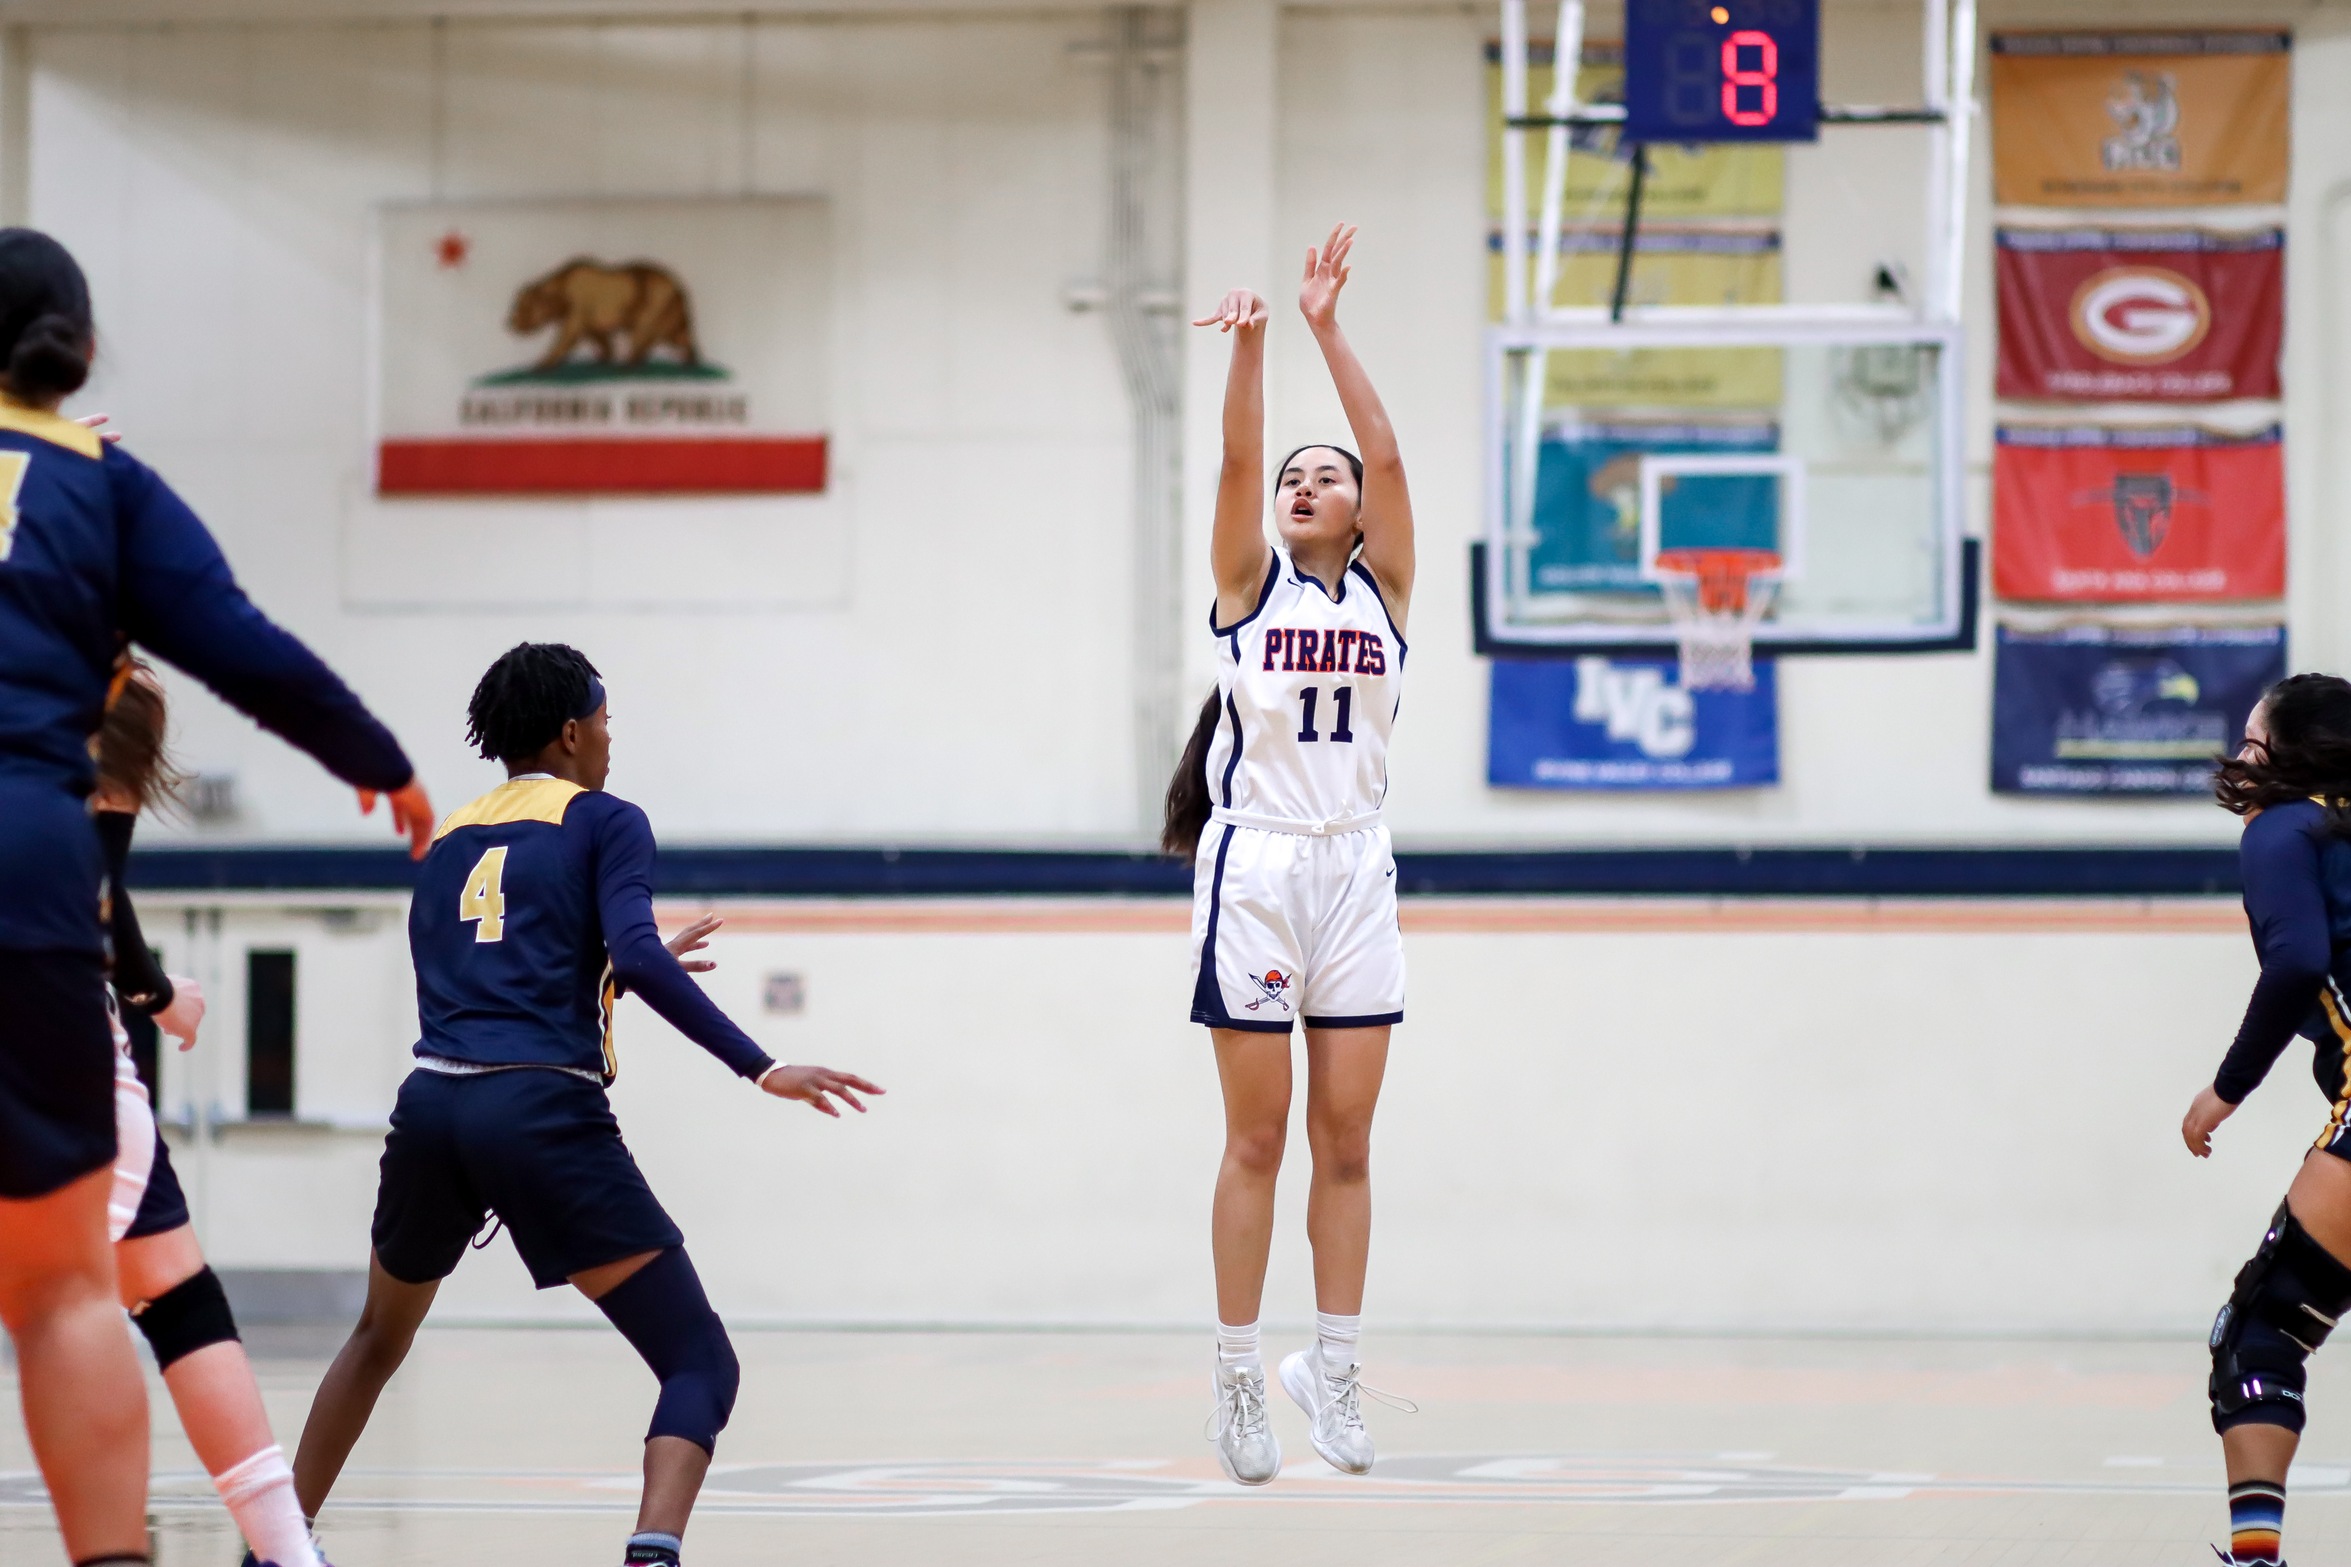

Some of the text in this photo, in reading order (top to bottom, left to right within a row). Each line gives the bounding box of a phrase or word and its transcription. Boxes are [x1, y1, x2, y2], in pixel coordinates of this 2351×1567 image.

[1721, 30, 1777, 126] 8
[2083, 276, 2197, 355] G
[1262, 628, 1386, 676] PIRATES
[1297, 686, 1353, 743] 11
[460, 845, 508, 943] 4
